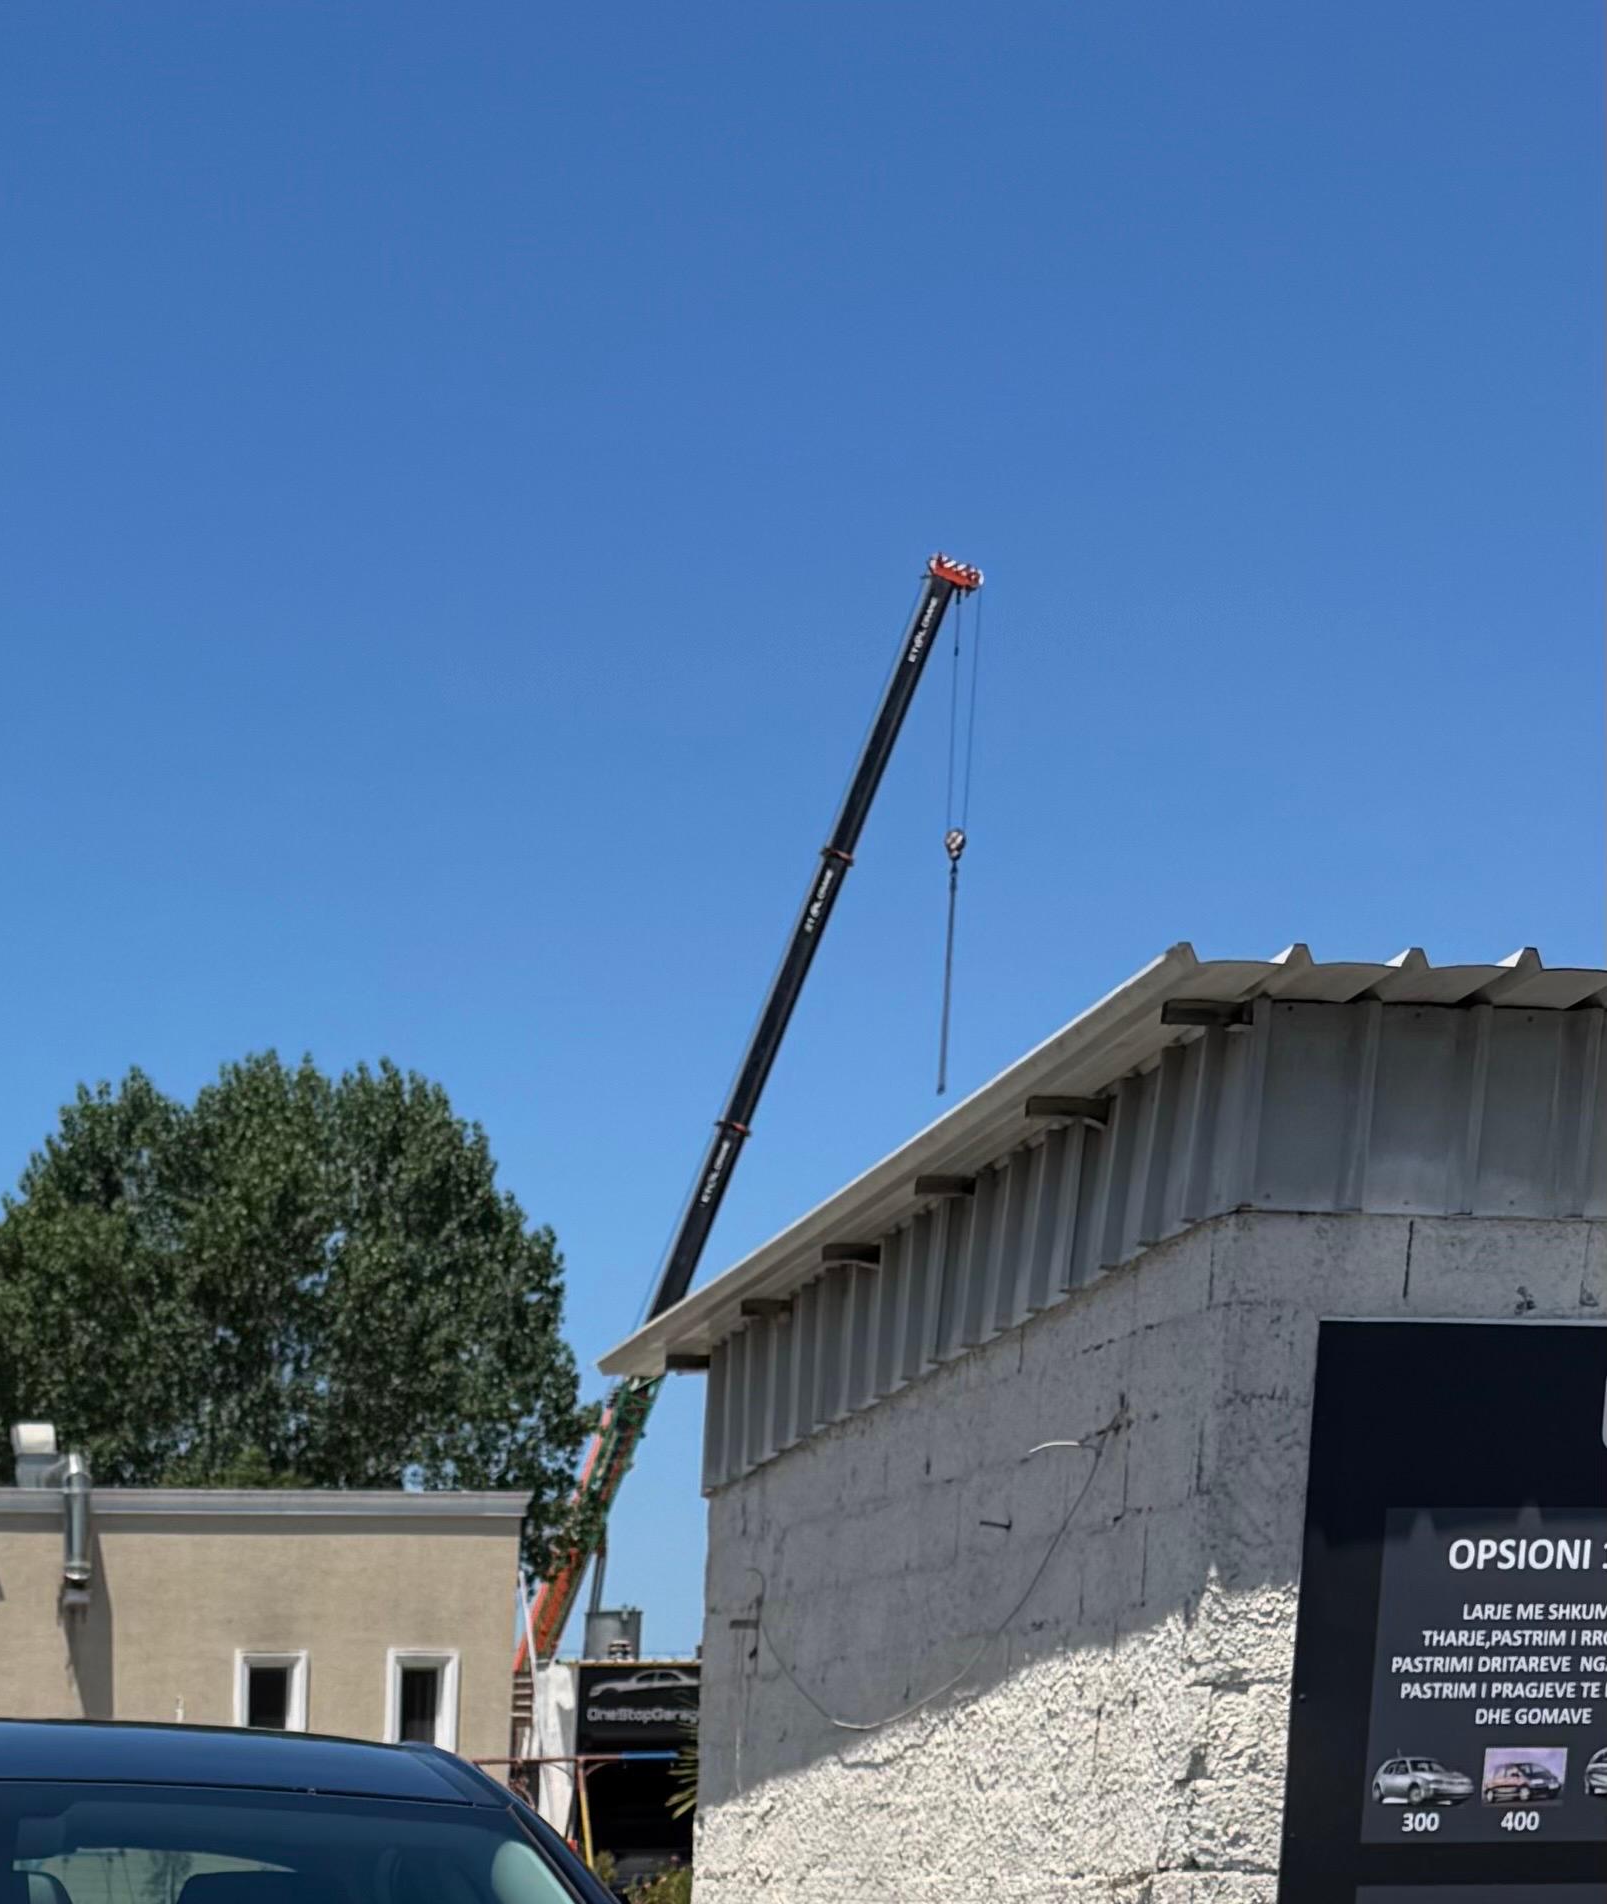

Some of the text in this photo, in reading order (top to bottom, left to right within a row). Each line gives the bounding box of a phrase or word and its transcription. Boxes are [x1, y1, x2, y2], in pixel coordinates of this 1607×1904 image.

[1448, 1538, 1592, 1570] OPSIONI
[1462, 1603, 1513, 1621] LARJE
[1516, 1603, 1545, 1621] ME
[1422, 1629, 1567, 1650] THARJE,PASTRIM
[1570, 1629, 1577, 1647] I
[1391, 1655, 1607, 1673] PASTRIMI DRITAREVE NG
[1400, 1682, 1477, 1700] PASTRIM
[1480, 1682, 1488, 1699] I
[1491, 1682, 1577, 1699] PRAGJEVE
[1580, 1682, 1601, 1699] TE
[1474, 1707, 1593, 1725] DHE GOMAVE
[1401, 1811, 1440, 1832] 300
[1500, 1810, 1540, 1832] 400
